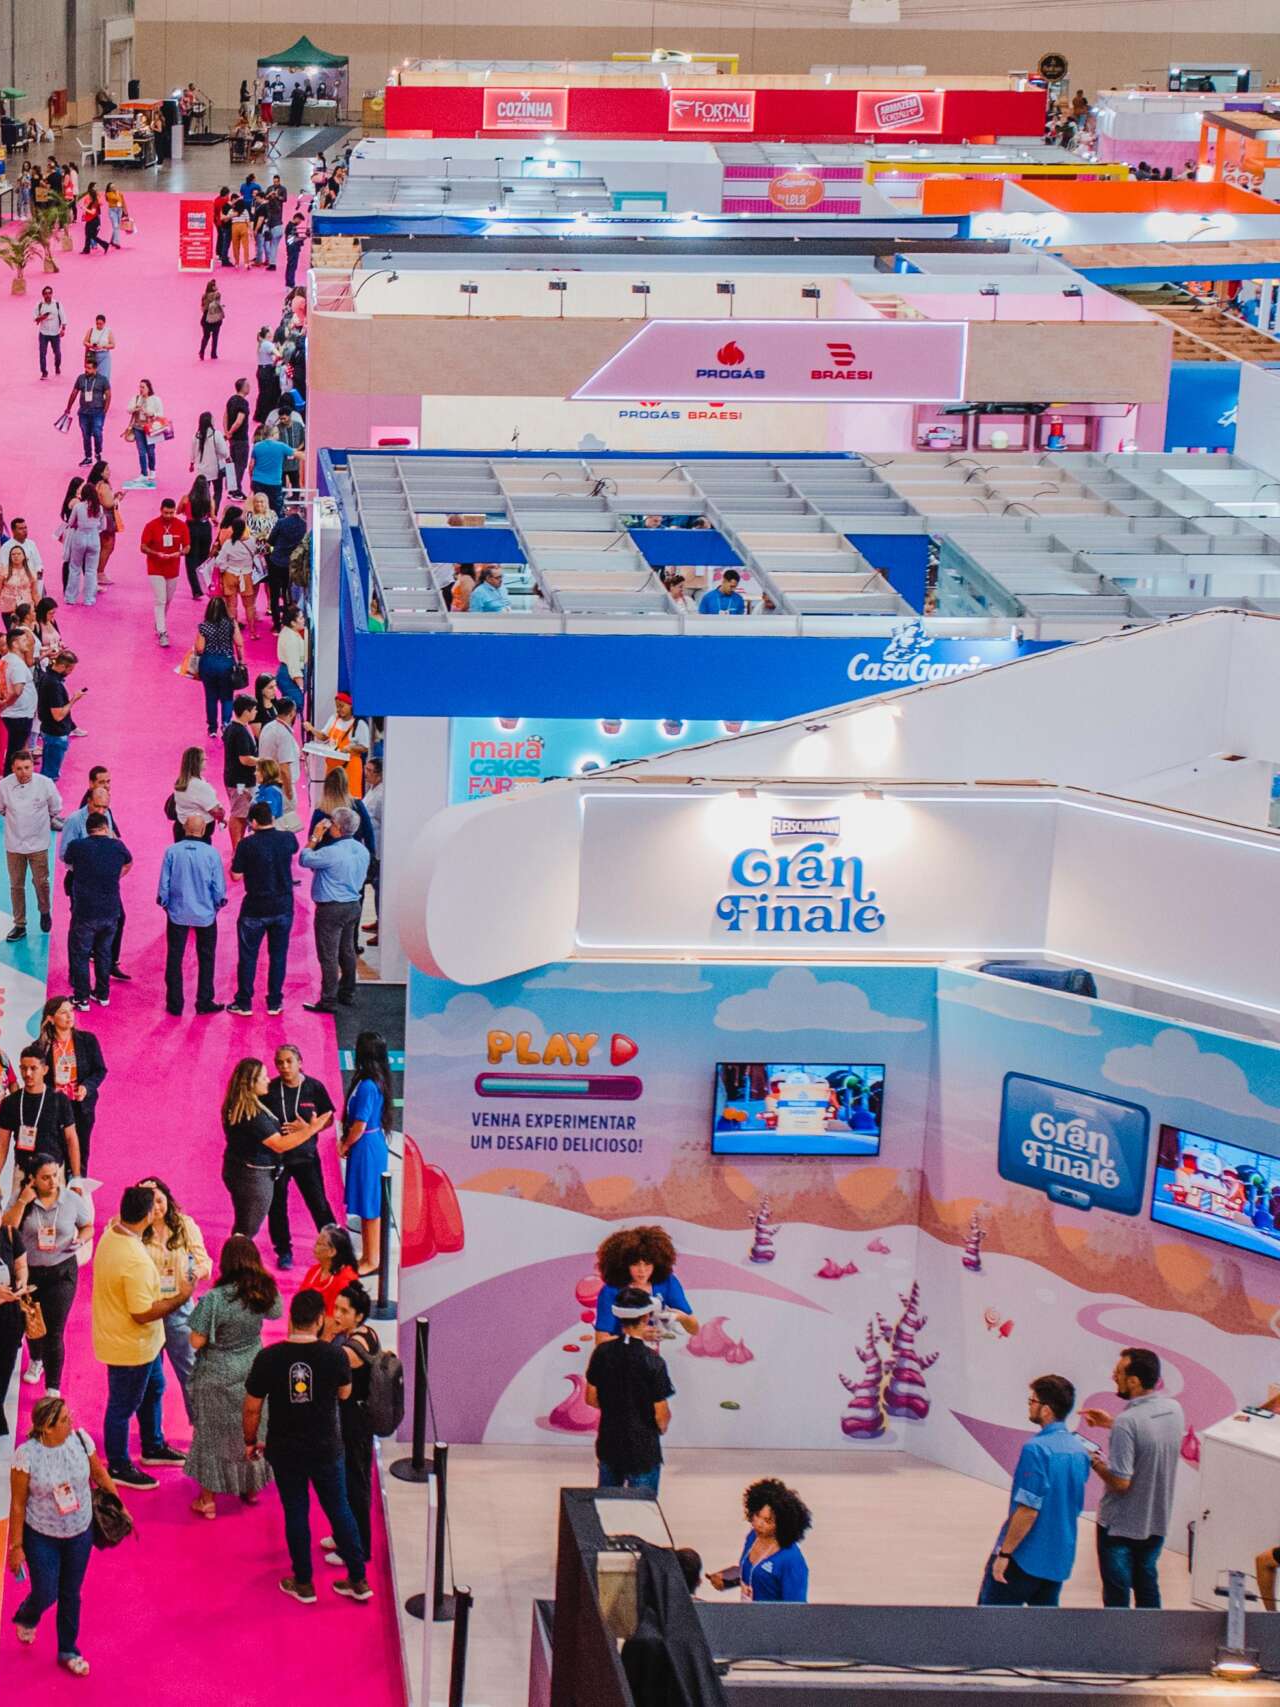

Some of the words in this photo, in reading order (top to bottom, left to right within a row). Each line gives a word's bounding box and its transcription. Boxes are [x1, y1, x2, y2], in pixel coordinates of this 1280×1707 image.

[497, 102, 553, 117] COZINHA
[696, 367, 766, 380] PROGÁS
[811, 370, 873, 380] BRAESI
[688, 411, 743, 420] BRAESI
[847, 652, 993, 682] CasaGarci
[470, 741, 542, 759] mara
[469, 759, 541, 777] cakes
[468, 777, 513, 795] FAIR
[731, 842, 876, 903] Gran
[716, 893, 886, 933] Finale
[487, 1029, 600, 1067] PLAY
[472, 1112, 521, 1128] VENHA
[526, 1113, 636, 1130] EXPERIMENTAR
[471, 1135, 492, 1150] UM
[497, 1135, 558, 1151] DESAFIO
[563, 1137, 643, 1154] DELICIOSO!
[1030, 1112, 1116, 1169] Gran
[1021, 1139, 1121, 1189] Finale
